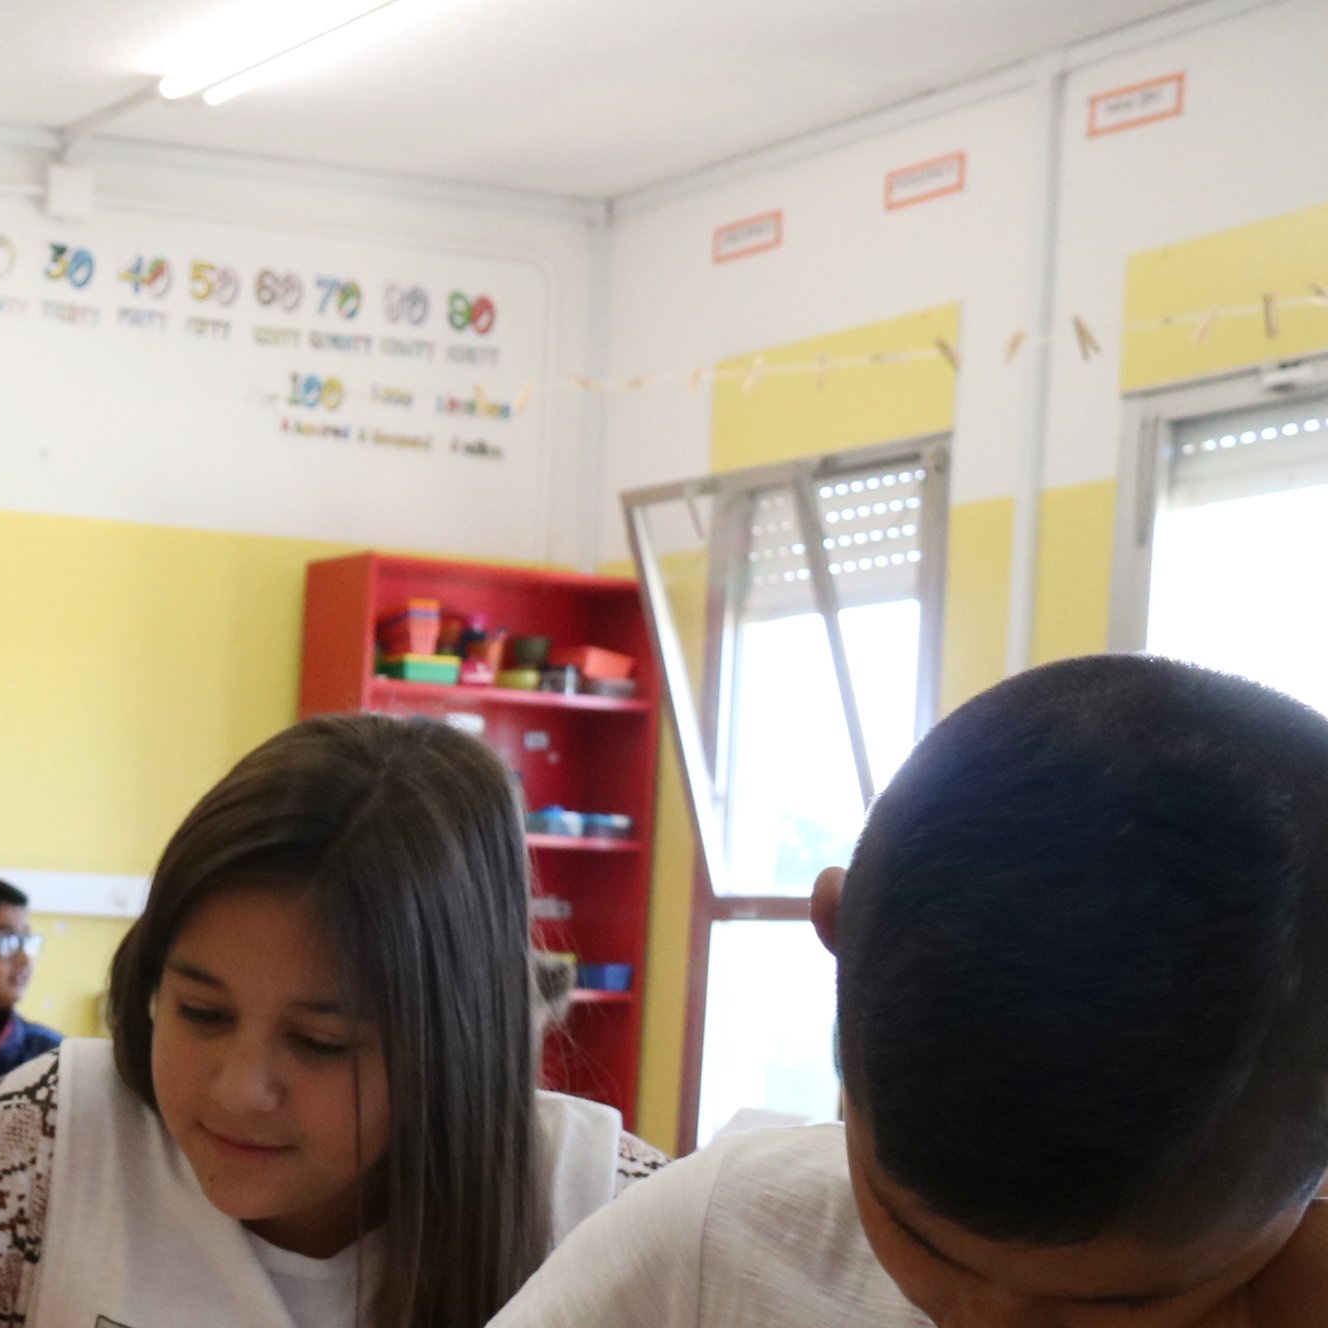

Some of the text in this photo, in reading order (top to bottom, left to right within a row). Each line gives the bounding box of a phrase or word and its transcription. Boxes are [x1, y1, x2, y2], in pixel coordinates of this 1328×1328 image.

[44, 241, 95, 289] 30
[117, 255, 171, 298] 40
[191, 259, 239, 308] 50
[255, 268, 303, 314] 60
[316, 274, 362, 320] 70
